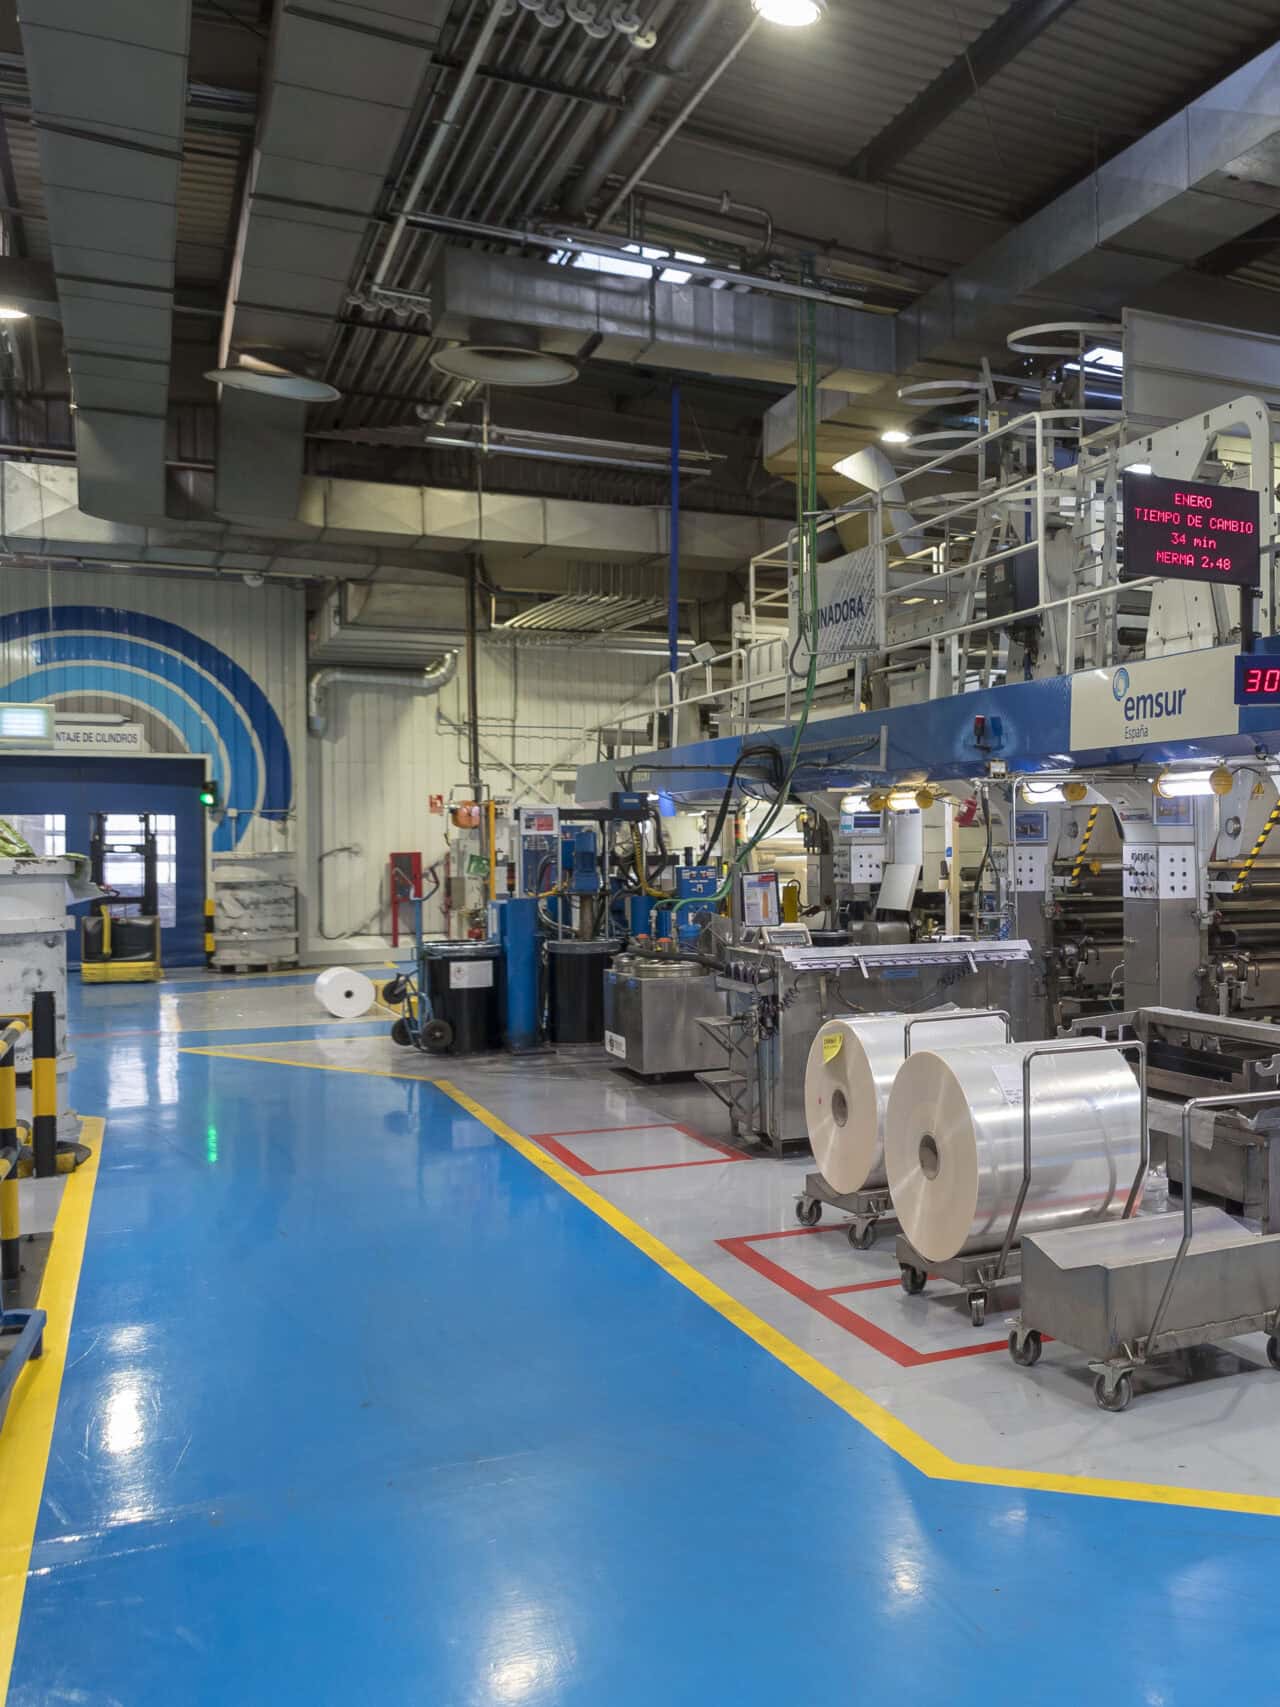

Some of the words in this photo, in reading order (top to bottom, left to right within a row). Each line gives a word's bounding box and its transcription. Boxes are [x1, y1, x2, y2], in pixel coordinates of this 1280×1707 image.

[1175, 493, 1212, 509] ENERO
[1135, 508, 1180, 525] TIEMPO
[1187, 514, 1202, 528] DE
[1209, 517, 1253, 534] CAMBIO
[1171, 532, 1186, 545] 34
[1193, 536, 1216, 549] min
[1156, 551, 1195, 567] MERMA
[806, 595, 866, 632] INADORA
[1124, 688, 1187, 721] emsur
[56, 732, 80, 743] NTAJE
[83, 732, 94, 743] DE
[95, 732, 138, 744] CILINDROS
[1124, 724, 1149, 742] España
